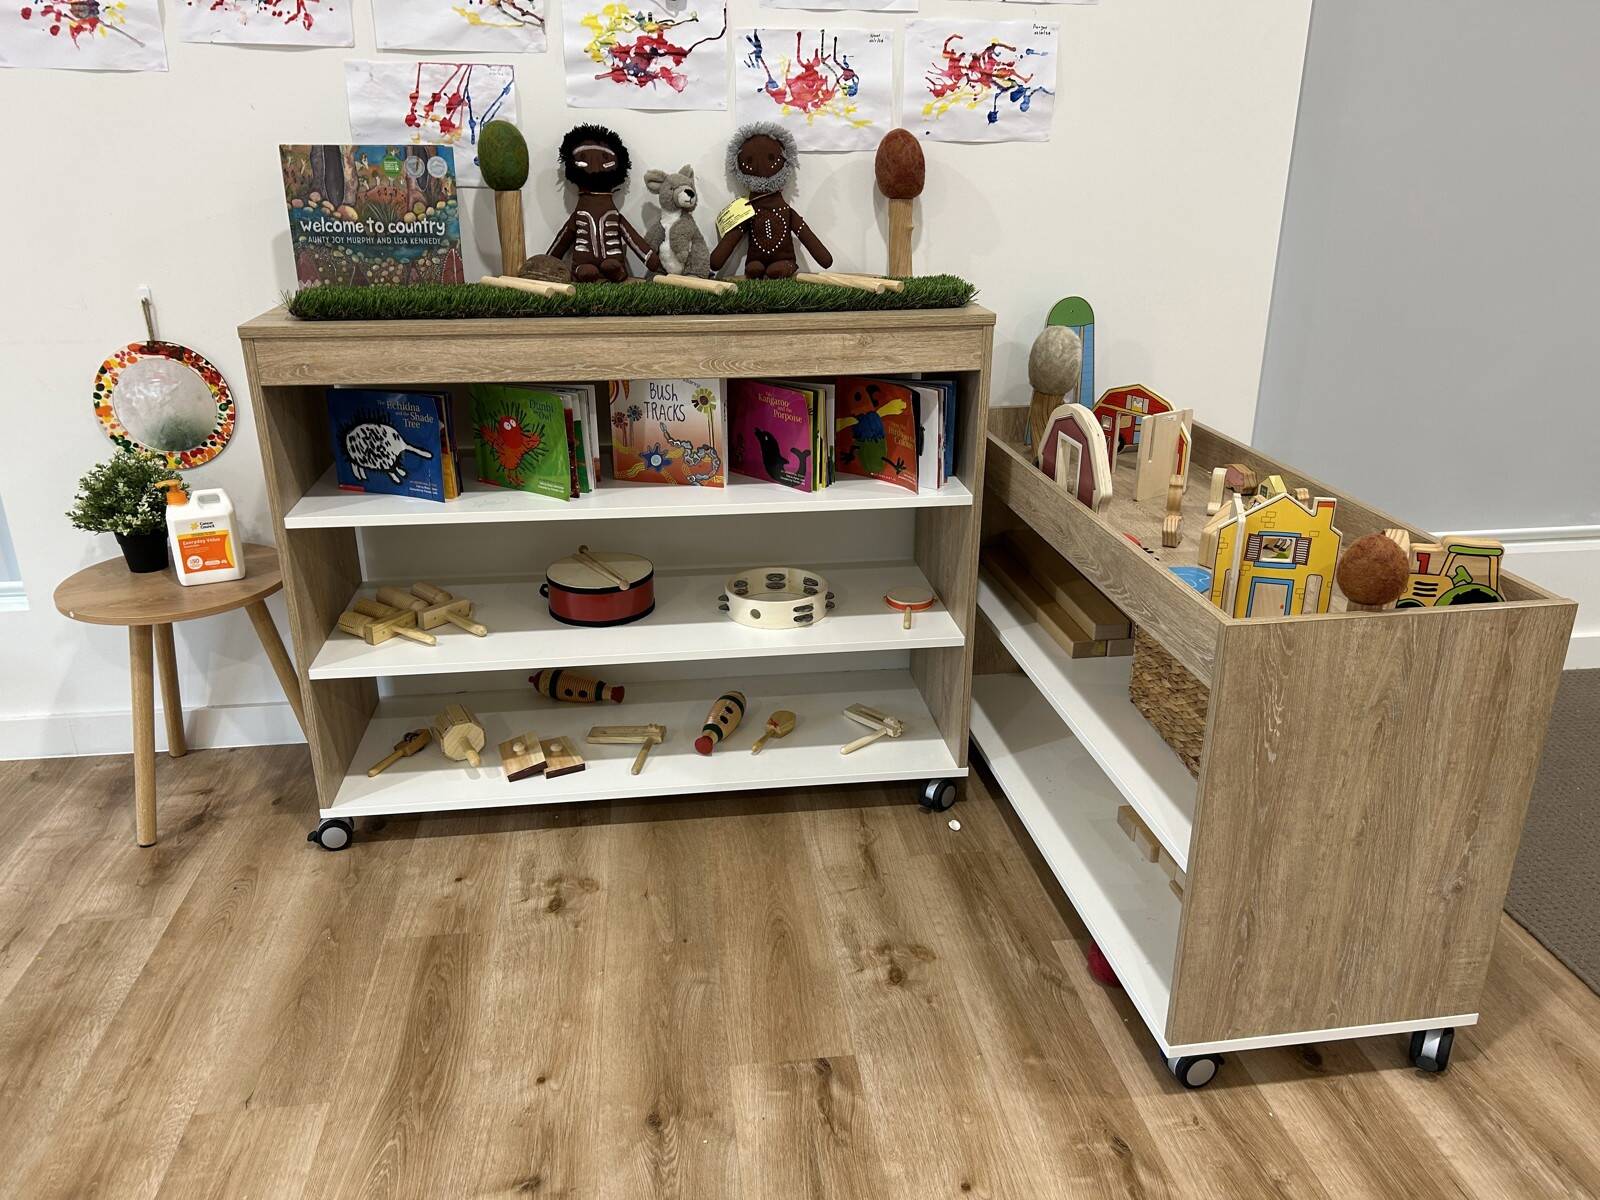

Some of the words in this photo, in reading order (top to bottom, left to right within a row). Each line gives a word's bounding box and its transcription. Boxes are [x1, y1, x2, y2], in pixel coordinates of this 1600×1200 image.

[300, 217, 364, 233] welcome
[366, 217, 385, 233] to
[388, 218, 446, 236] country
[308, 236, 330, 244] AUNTY
[331, 236, 345, 244] JOY
[346, 236, 375, 245] MURPHY
[376, 236, 393, 245] AND
[393, 236, 408, 245] LISA
[409, 237, 441, 245] KENNEDY
[386, 400, 421, 412] Echidna
[644, 401, 686, 422] TRACKS
[403, 418, 421, 429] Tree
[409, 412, 434, 424] Shade
